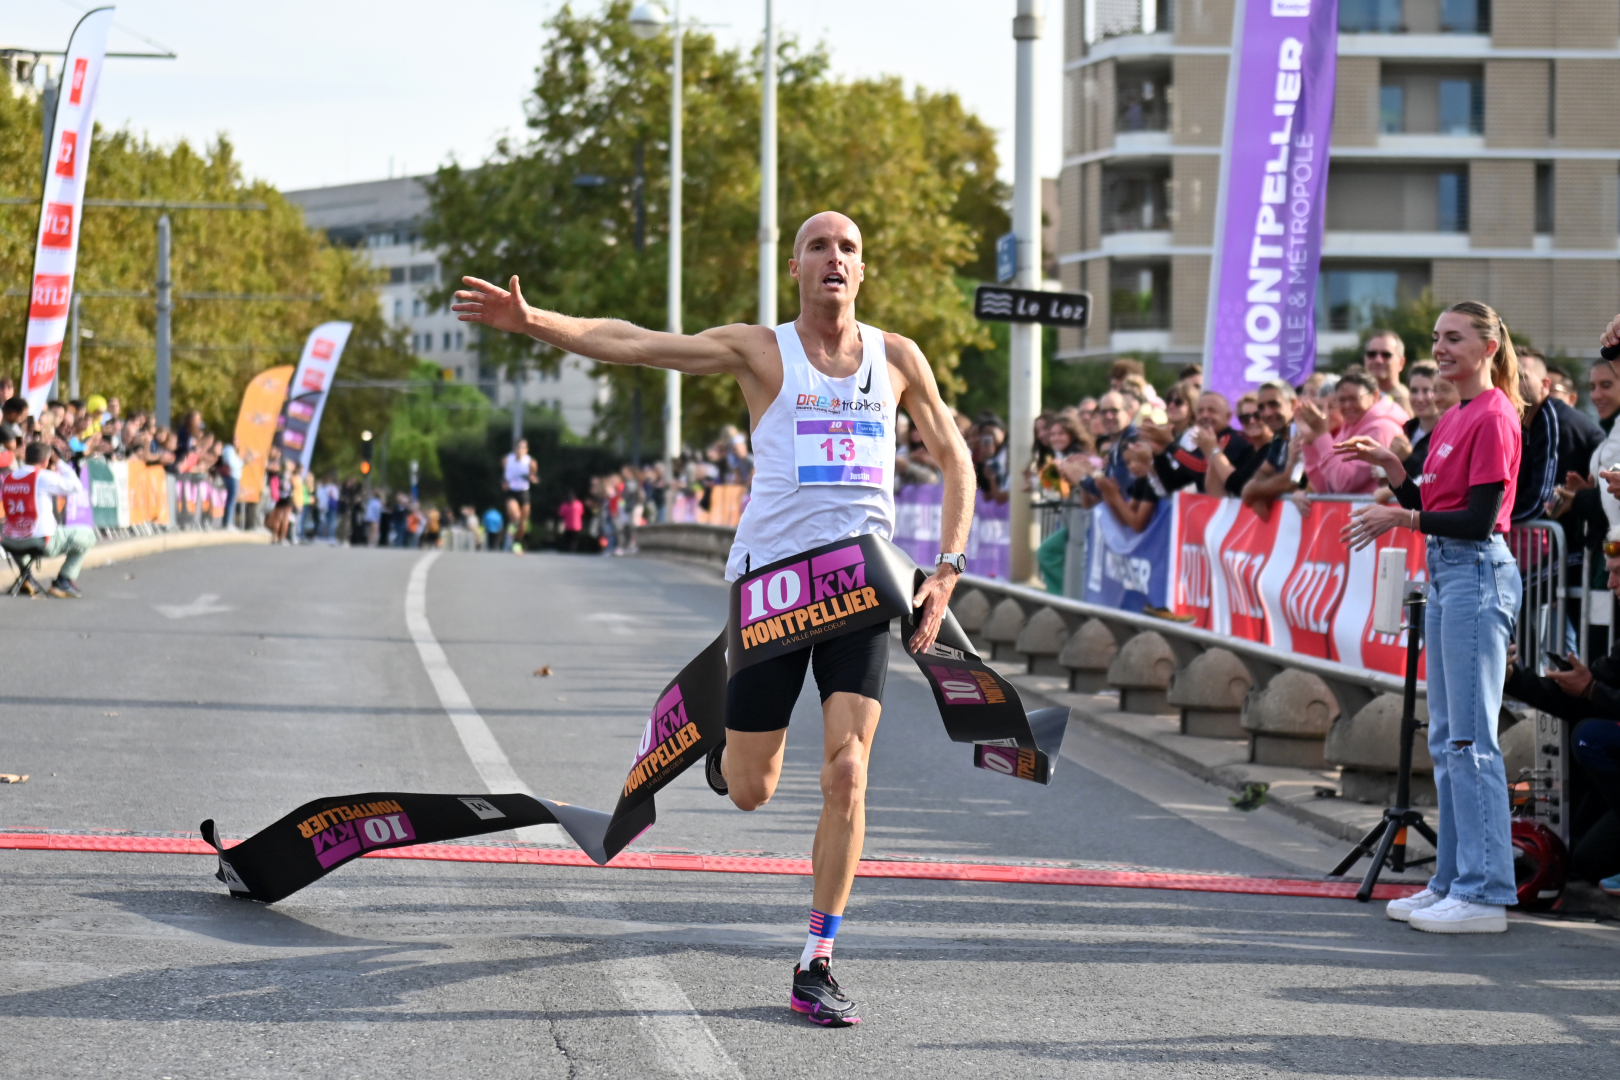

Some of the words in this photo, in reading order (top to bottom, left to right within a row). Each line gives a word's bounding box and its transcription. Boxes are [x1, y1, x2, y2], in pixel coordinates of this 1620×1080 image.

[1244, 37, 1303, 382] MONTPELLIER
[1287, 132, 1314, 284] MÉTROPOLE
[32, 286, 67, 306] RTL2
[1017, 297, 1040, 317] Le
[1049, 300, 1084, 320] Lez
[1286, 315, 1306, 379] VILLE
[831, 421, 843, 429] 10
[820, 438, 856, 461] 13
[4, 482, 30, 494] PHOTO
[850, 472, 870, 481] Justin
[8, 499, 25, 515] 24
[747, 569, 801, 621] 10
[813, 563, 867, 602] KM
[1286, 561, 1345, 635] RTL2
[741, 586, 880, 650] MONTPELLIER
[781, 638, 791, 646] LA
[791, 631, 809, 643] VILLE
[810, 627, 823, 637] PAR
[823, 619, 847, 632] COEUR
[941, 680, 981, 701] 10
[631, 718, 652, 769] 0
[656, 700, 689, 745] KM
[624, 721, 702, 798] MONTPELLIER
[297, 800, 404, 839] MONTPELLIER
[363, 815, 408, 843] 10
[311, 820, 357, 856] KM
